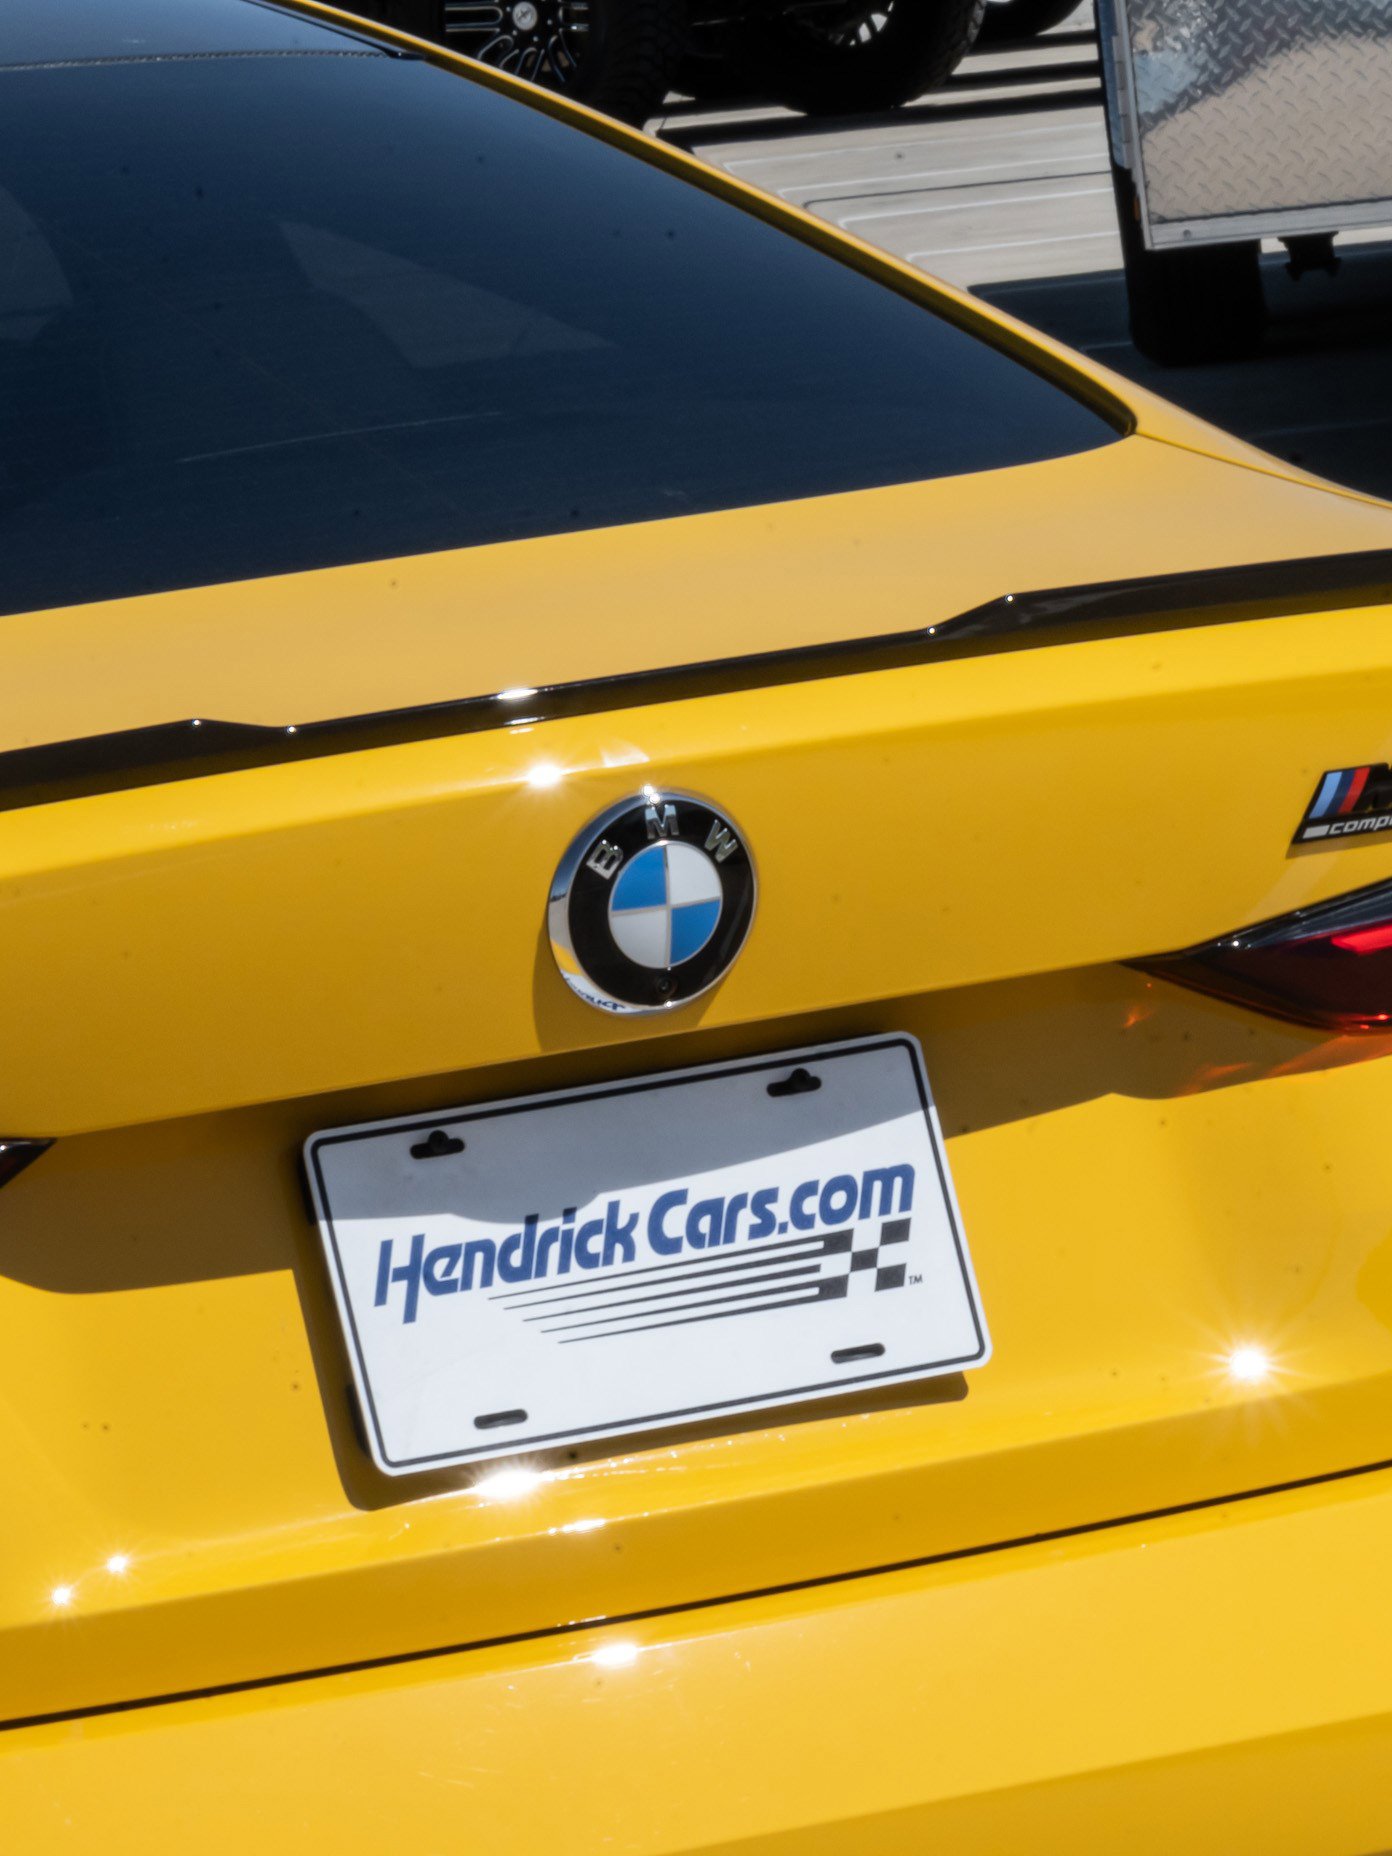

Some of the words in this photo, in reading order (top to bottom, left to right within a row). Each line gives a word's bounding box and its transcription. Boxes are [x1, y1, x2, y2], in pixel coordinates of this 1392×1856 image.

[586, 804, 739, 880] BMW
[373, 1201, 638, 1324] Hendrick
[647, 1163, 916, 1255] Cars.com
